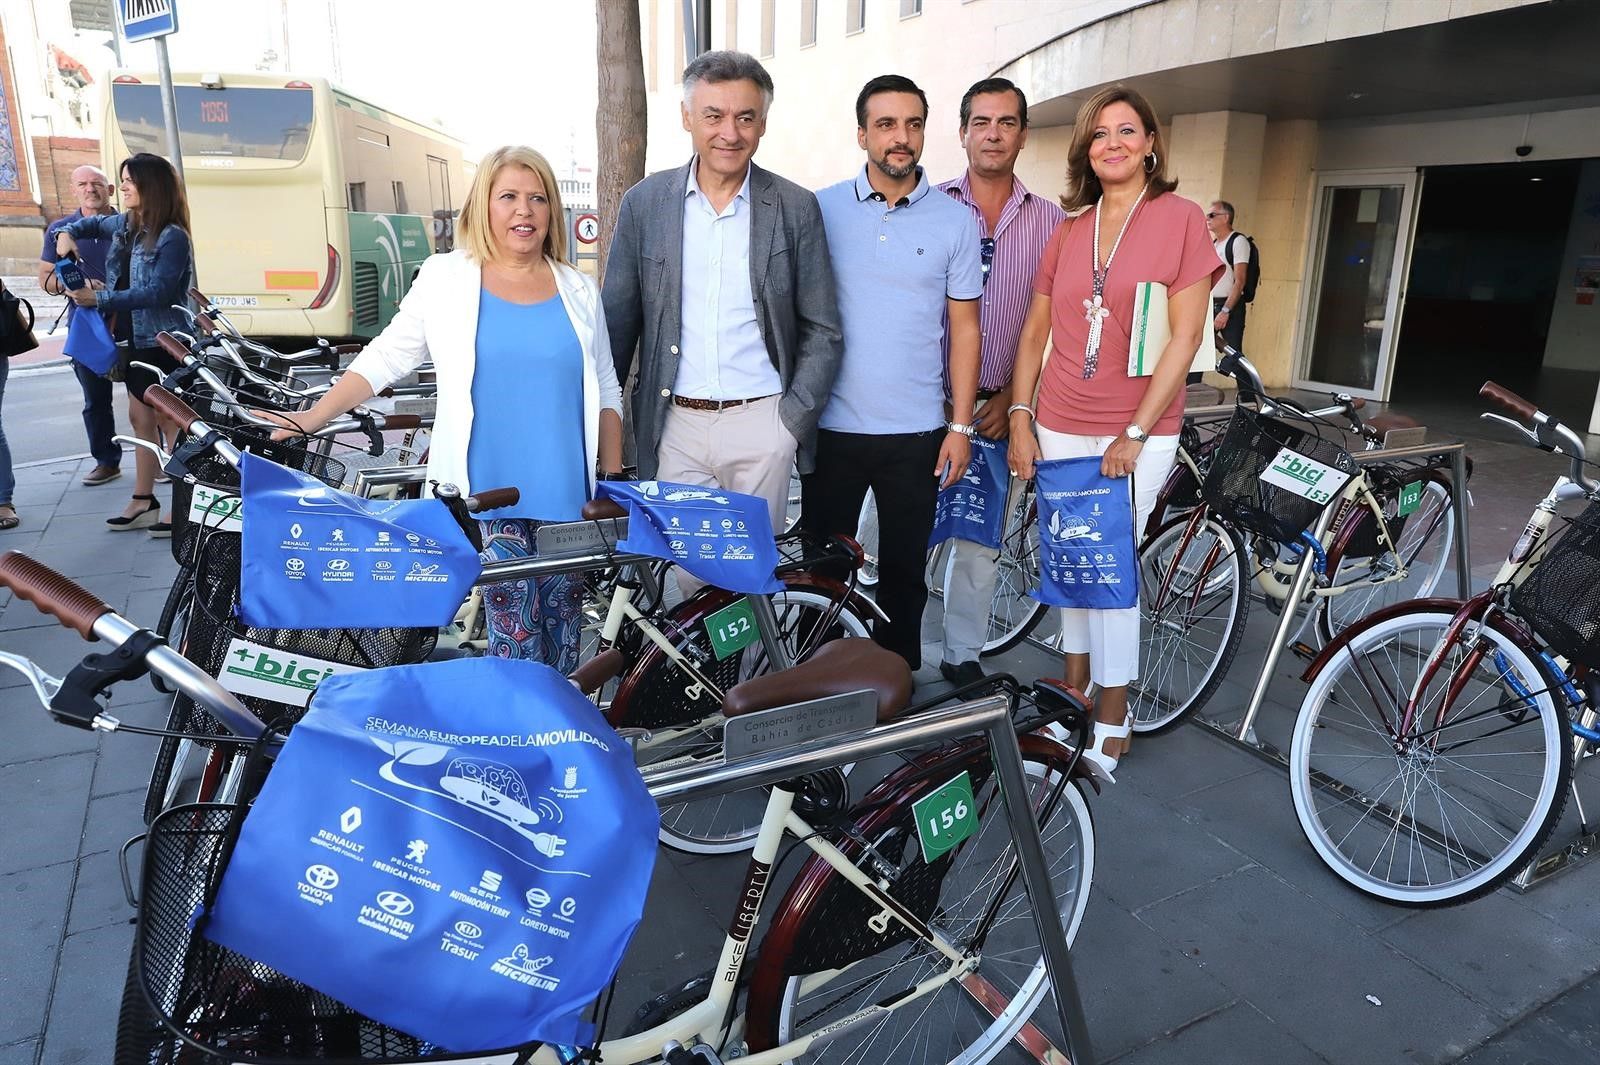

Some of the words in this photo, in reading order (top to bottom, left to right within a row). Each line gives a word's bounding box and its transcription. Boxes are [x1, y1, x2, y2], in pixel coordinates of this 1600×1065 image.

[1282, 454, 1327, 483] +bici
[197, 491, 242, 515] +bi
[1304, 487, 1330, 503] 153
[1403, 492, 1418, 506] 153
[551, 525, 586, 535] Consorcio
[372, 573, 396, 581] Trasur
[719, 617, 751, 642] 152
[744, 714, 793, 731] Consorcio
[798, 722, 812, 733] de
[549, 786, 588, 794] Ayuntamiento
[930, 800, 968, 837] 156
[318, 829, 365, 853] RENAULT
[372, 860, 409, 880] IBERICAR
[408, 875, 442, 892] MOTORS
[390, 857, 432, 876] PEUGEOT
[297, 882, 334, 903] TOYOTA
[469, 886, 501, 902] SEAT
[360, 905, 415, 934] HYUNDAI
[520, 917, 548, 933] LORETO
[548, 926, 570, 939] MOTOR
[441, 938, 479, 961] Trasur
[724, 942, 746, 982] BIKE
[490, 961, 558, 992] MICHELIN
